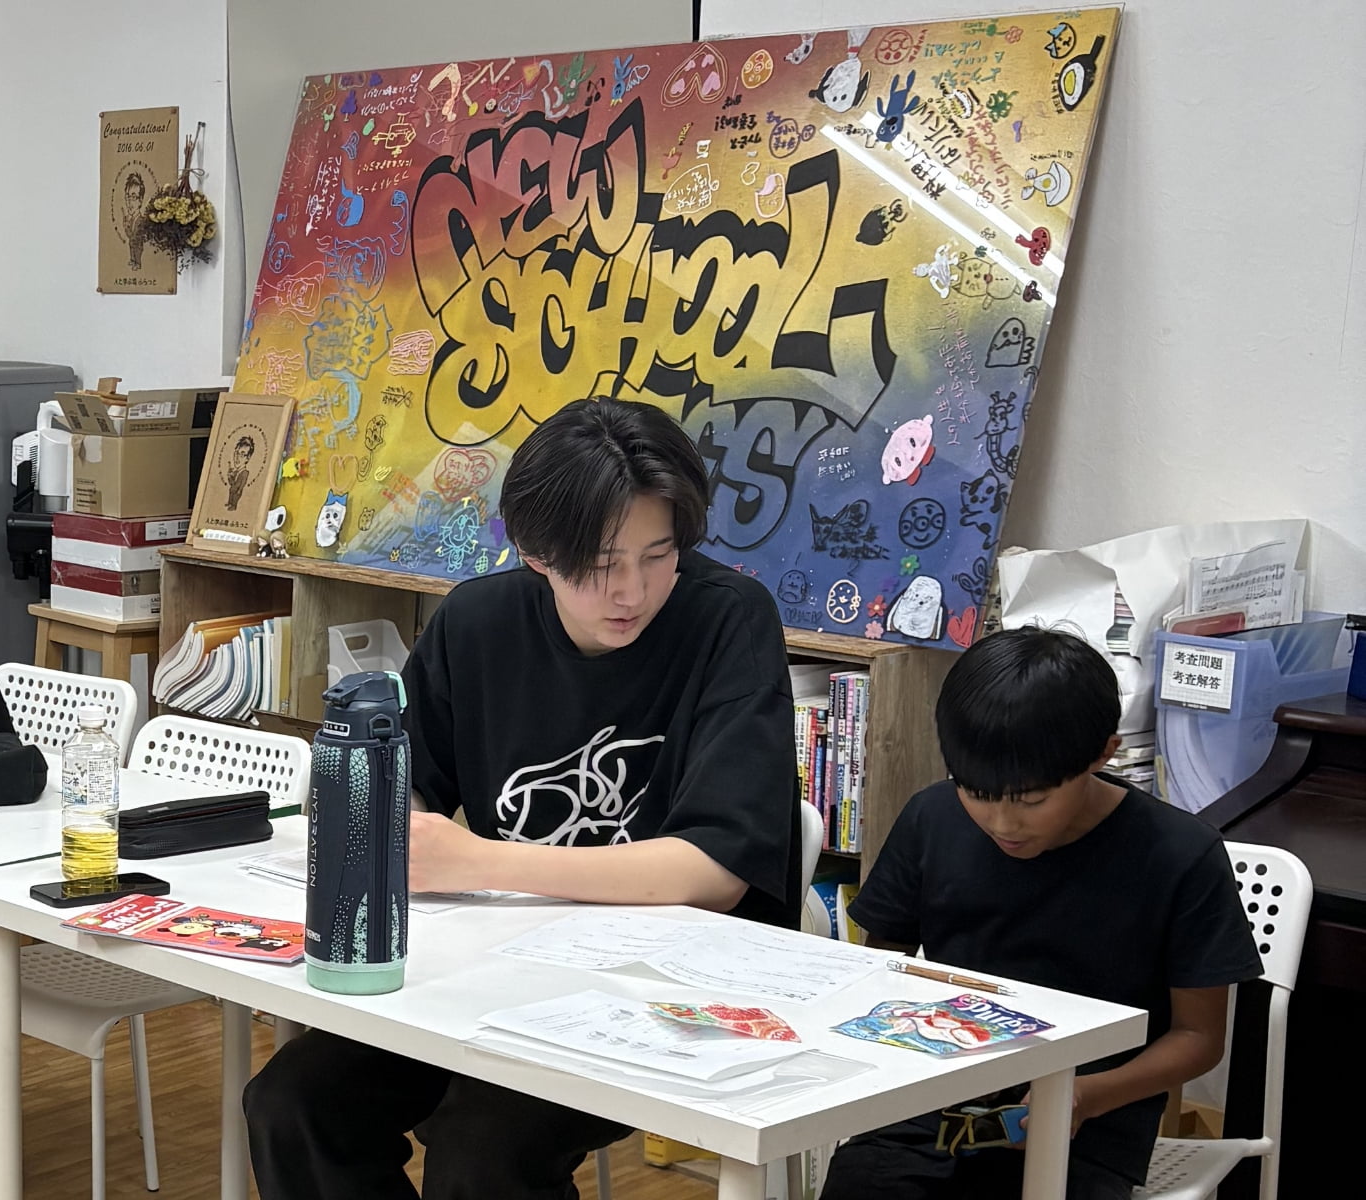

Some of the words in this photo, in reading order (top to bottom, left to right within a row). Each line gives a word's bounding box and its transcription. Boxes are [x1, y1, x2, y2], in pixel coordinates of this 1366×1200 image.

[103, 120, 171, 139] Congratulations!
[413, 99, 642, 317] NEW
[425, 150, 896, 445] SCHOOL
[1172, 670, 1221, 689] 考査解答
[1174, 651, 1223, 670] 考査問題
[309, 787, 319, 888] HYDRATION
